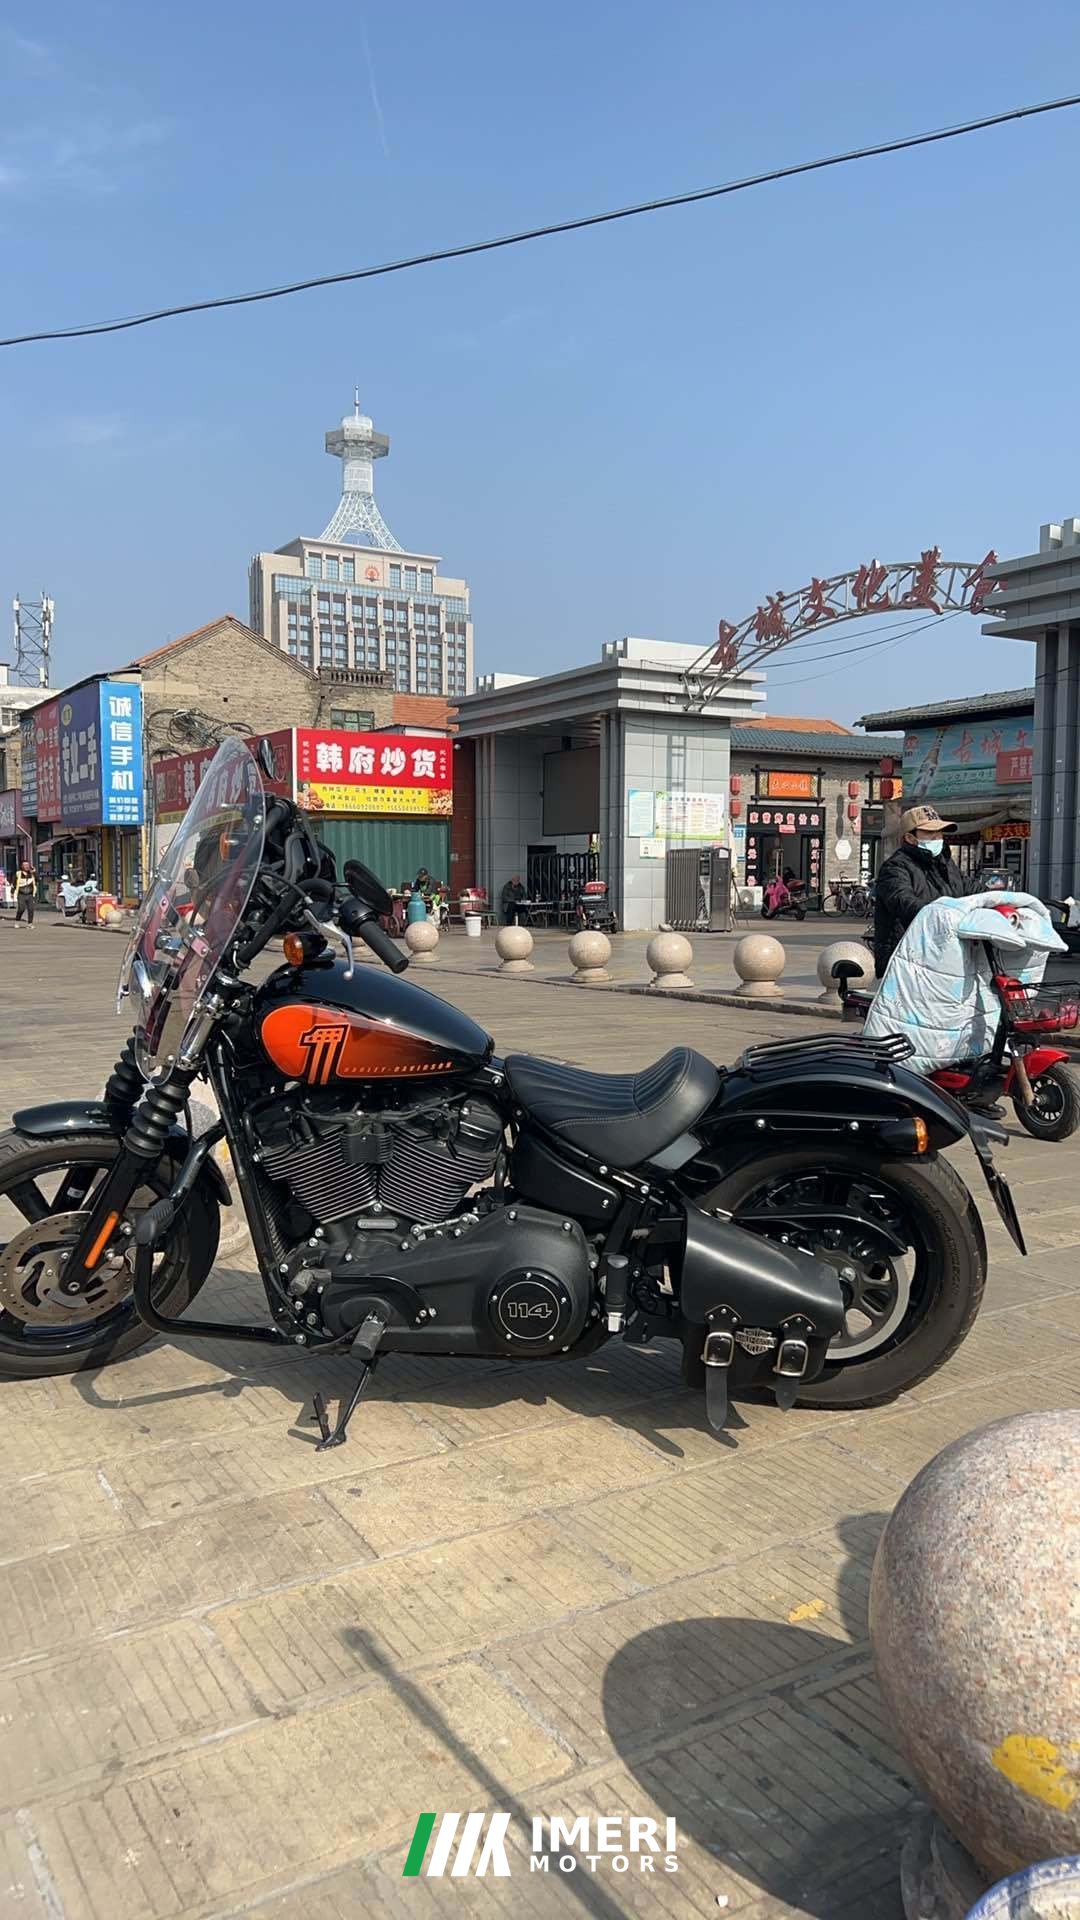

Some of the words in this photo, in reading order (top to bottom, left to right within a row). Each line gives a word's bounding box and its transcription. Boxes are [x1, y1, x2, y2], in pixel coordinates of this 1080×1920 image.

[109, 696, 134, 791] 诚信手机
[315, 742, 437, 779] 韩府炒货
[507, 1302, 553, 1319] 114
